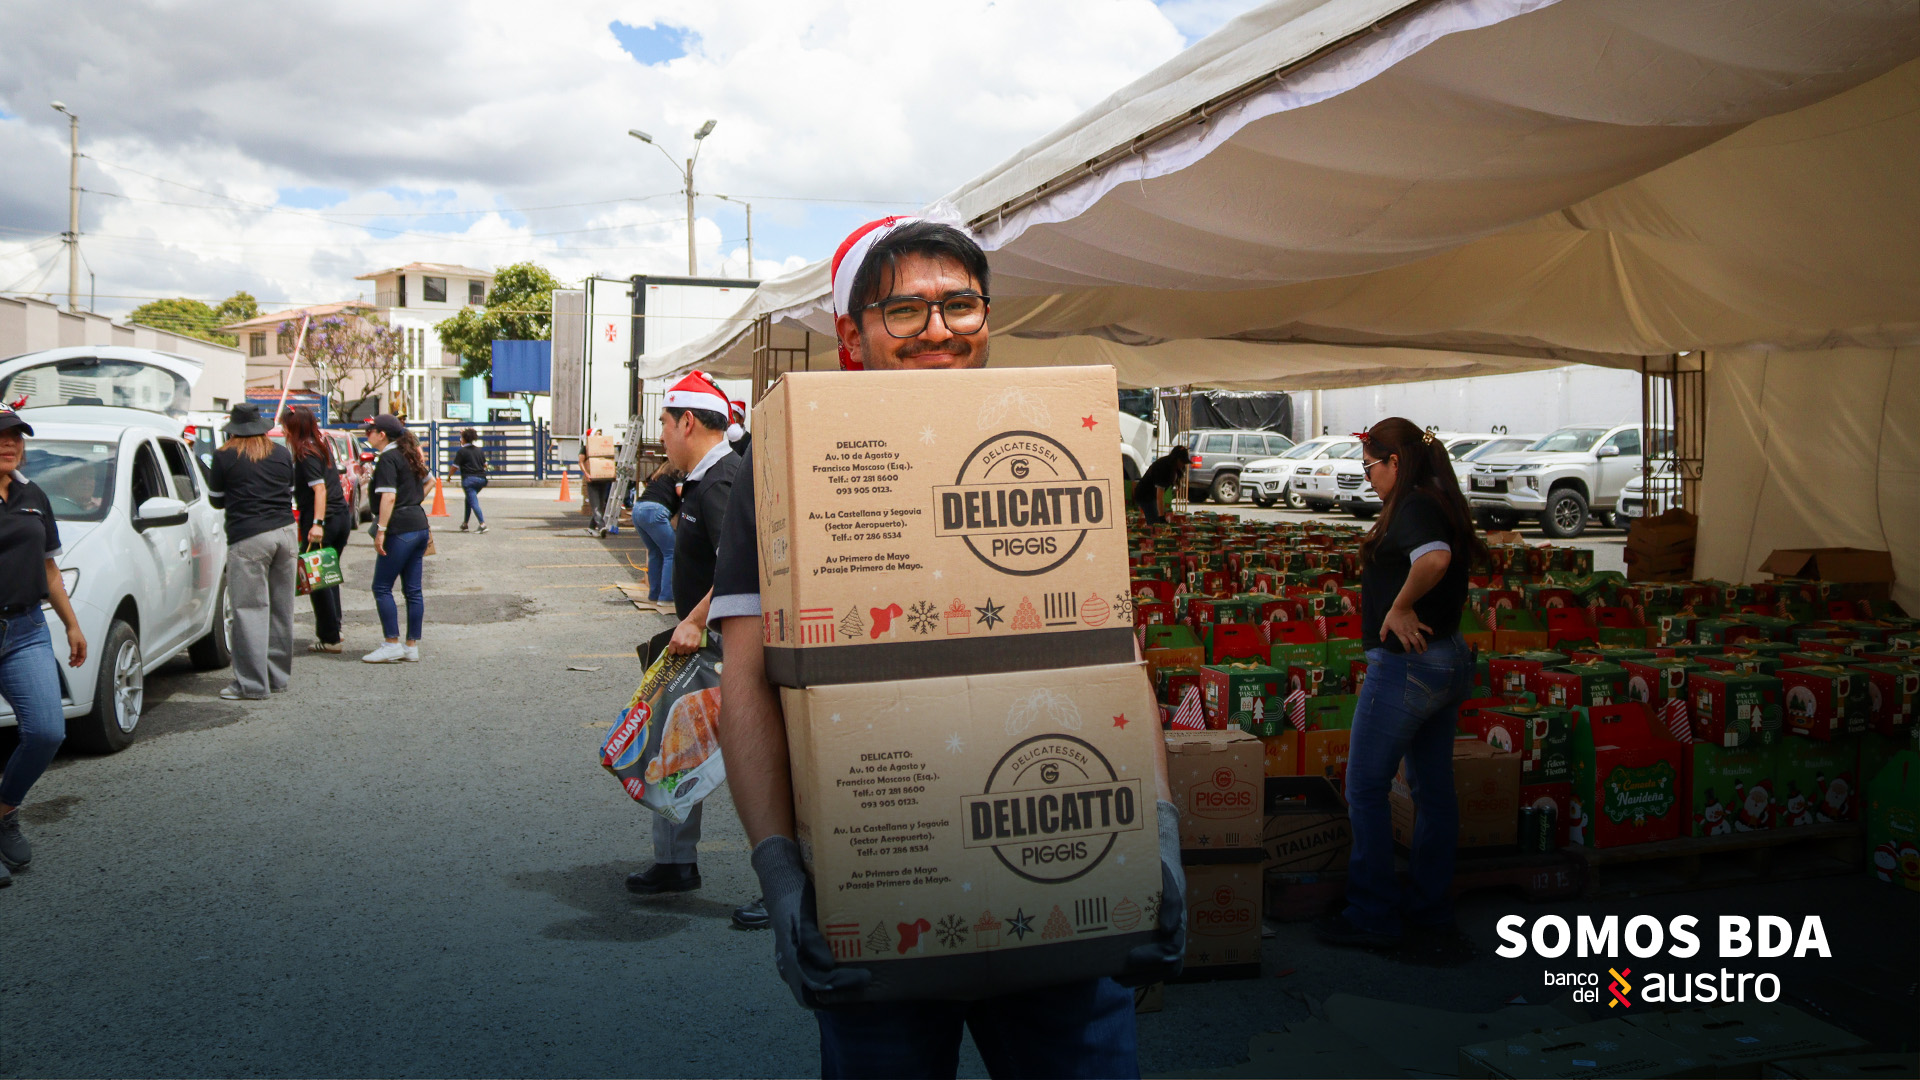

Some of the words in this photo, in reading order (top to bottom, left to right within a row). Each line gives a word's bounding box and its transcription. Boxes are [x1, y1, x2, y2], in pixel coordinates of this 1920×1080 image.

[836, 440, 887, 449] DELICATTO:
[864, 452, 892, 460] Agosto
[982, 442, 1058, 465] DELICATESSEN
[887, 462, 913, 471] (Esq.).
[838, 510, 881, 518] Castellana
[890, 508, 922, 516] Segovia
[942, 486, 1104, 530] DELICATTO
[825, 523, 853, 532] (Sector
[855, 520, 907, 529] Aeropuerto).
[832, 533, 852, 541] Telf.:
[992, 537, 1057, 557] PIGGIS
[887, 552, 910, 561] Mayo
[820, 566, 848, 574] Pasaje
[898, 562, 923, 571] Mayo.
[642, 666, 667, 696] Pierna
[606, 708, 646, 756] ITALIANA
[860, 750, 912, 762] DELICATTO:
[1011, 746, 1089, 771] DELICATESSEN
[890, 763, 918, 772] Agosto
[836, 778, 875, 787] Francisco
[913, 773, 940, 783] (Esq.).
[1623, 779, 1656, 791] Canasta
[852, 789, 874, 797] Telf.:
[1196, 791, 1251, 806] PIGGIS
[1616, 792, 1664, 807] Navideña
[971, 787, 1134, 840] DELICATTO
[863, 823, 908, 832] Castellana
[917, 819, 949, 829] Segovia
[850, 837, 878, 847] (Sector
[880, 832, 934, 843] Aeropuerto).
[1276, 827, 1348, 857] ITALIANA
[857, 848, 878, 856] Telf.:
[1022, 842, 1087, 866] PIGGIS
[865, 870, 900, 878] Primero
[914, 866, 938, 875] Mayo
[846, 881, 874, 890] Pasaje
[925, 876, 951, 884] Mayo.
[1197, 908, 1250, 924] PIGGIS
